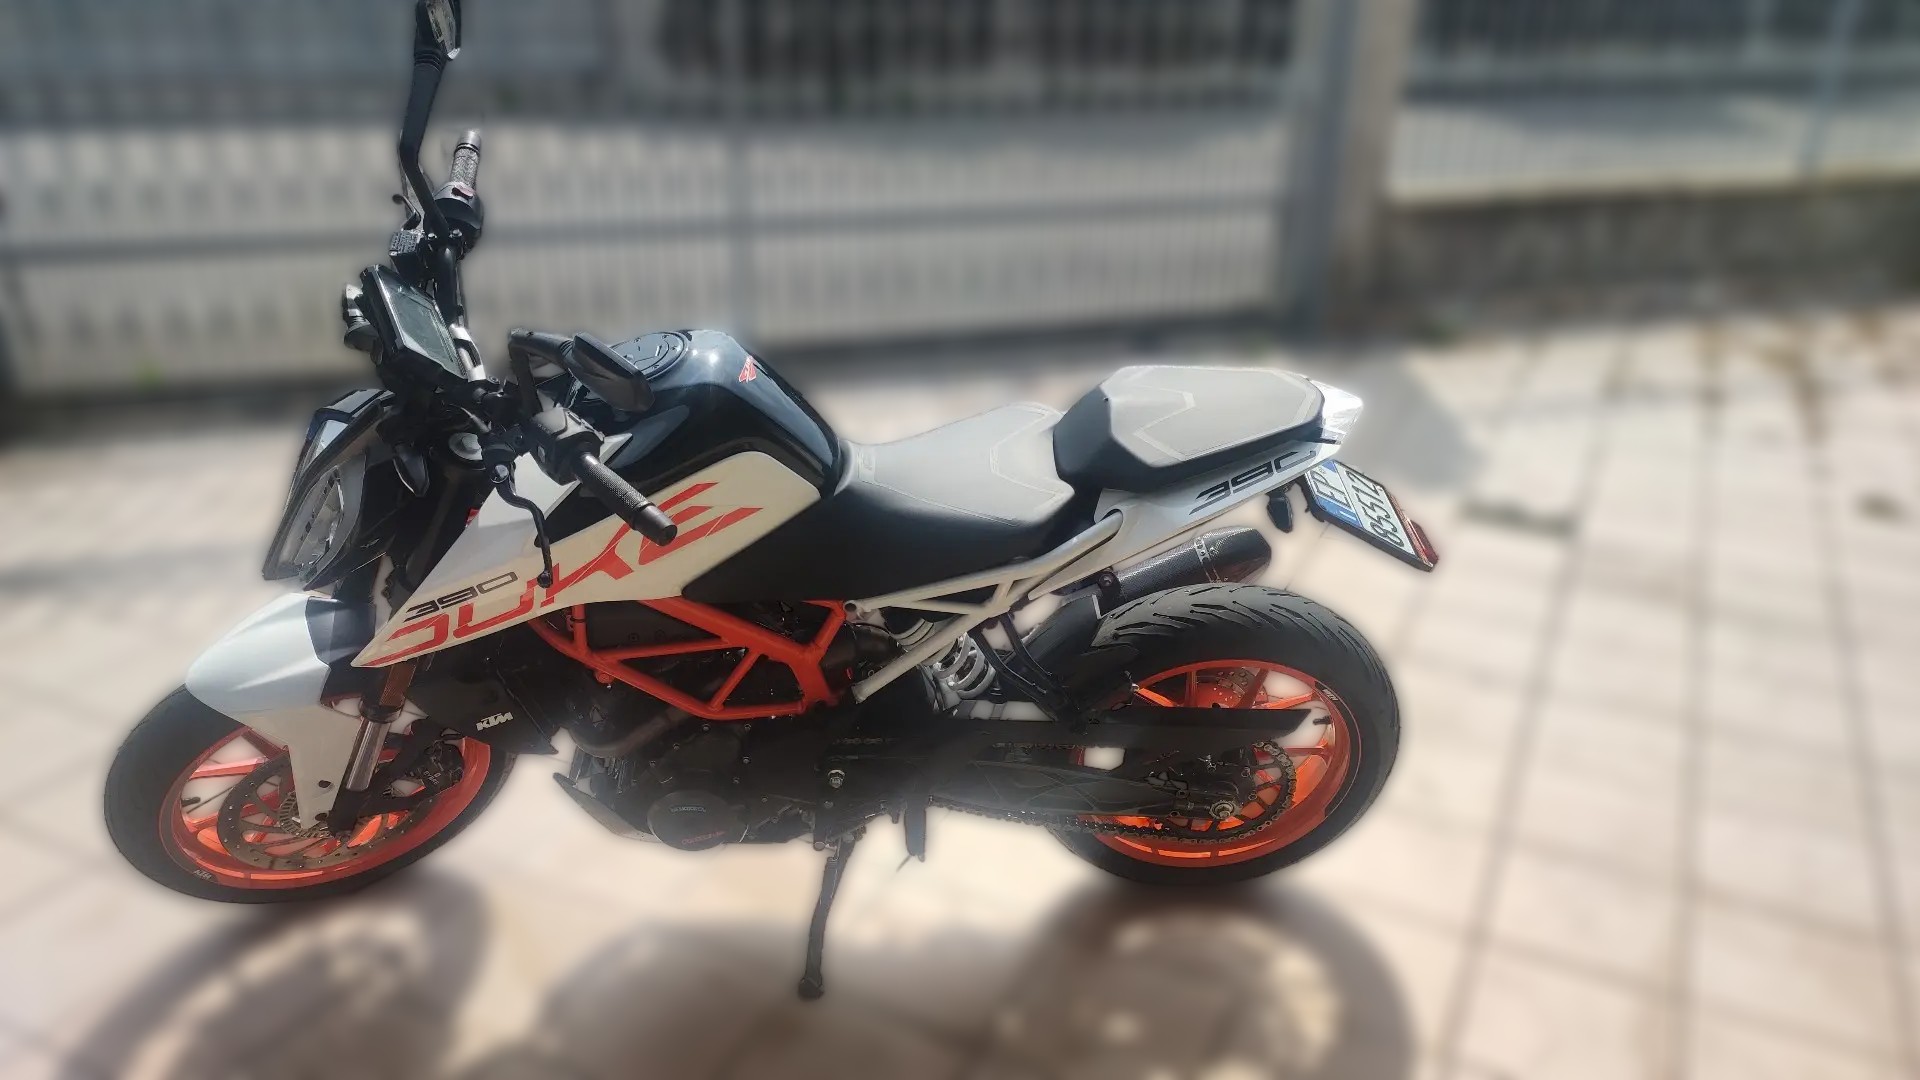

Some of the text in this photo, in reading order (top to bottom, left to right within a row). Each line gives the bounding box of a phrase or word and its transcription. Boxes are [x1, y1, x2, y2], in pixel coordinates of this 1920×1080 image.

[1310, 469, 1352, 509] EP
[1345, 470, 1405, 548] 85512
[362, 481, 763, 667] DUKE
[403, 571, 518, 623] 390
[476, 711, 514, 731] KTM
